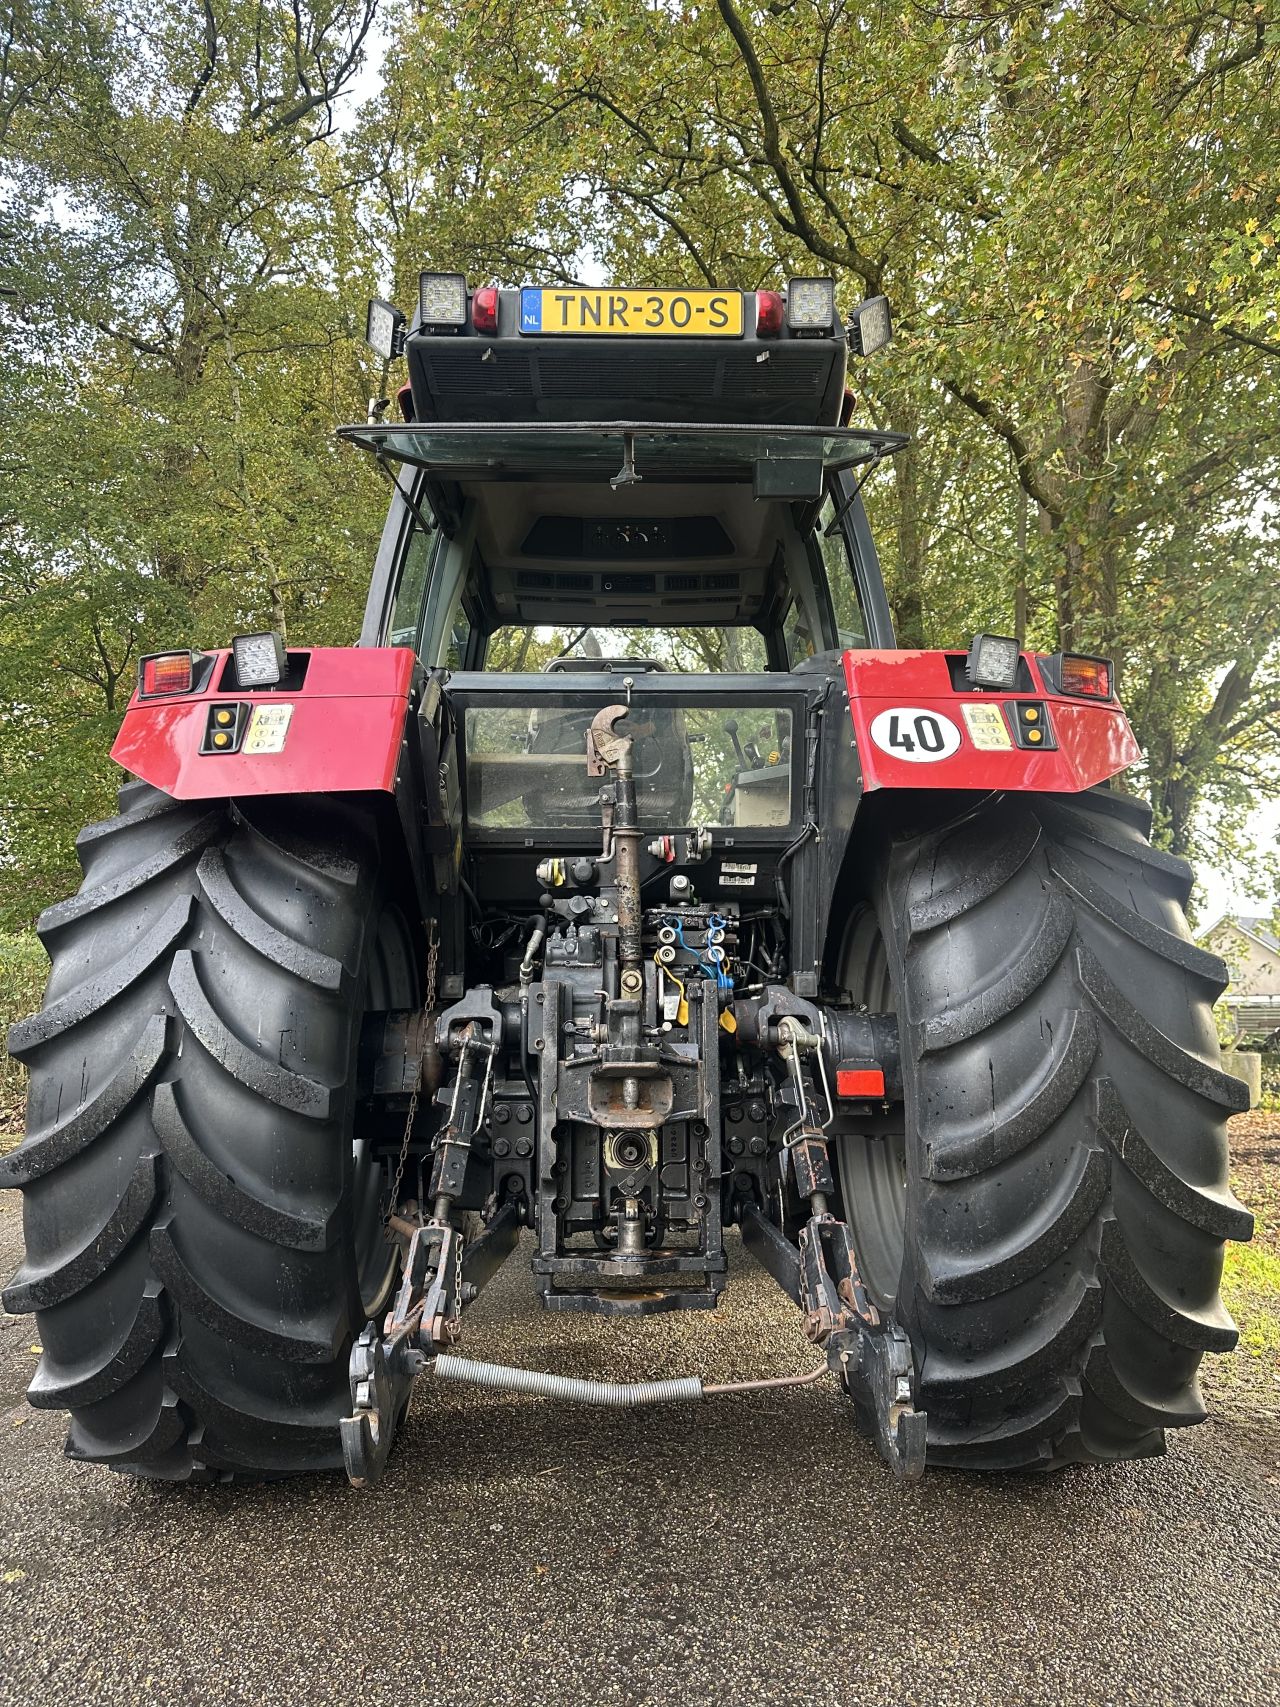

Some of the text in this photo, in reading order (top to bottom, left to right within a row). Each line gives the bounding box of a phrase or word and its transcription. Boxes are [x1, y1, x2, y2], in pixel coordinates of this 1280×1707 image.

[524, 315, 539, 325] NL
[555, 295, 729, 328] TNR-30-S
[889, 715, 945, 753] 40
